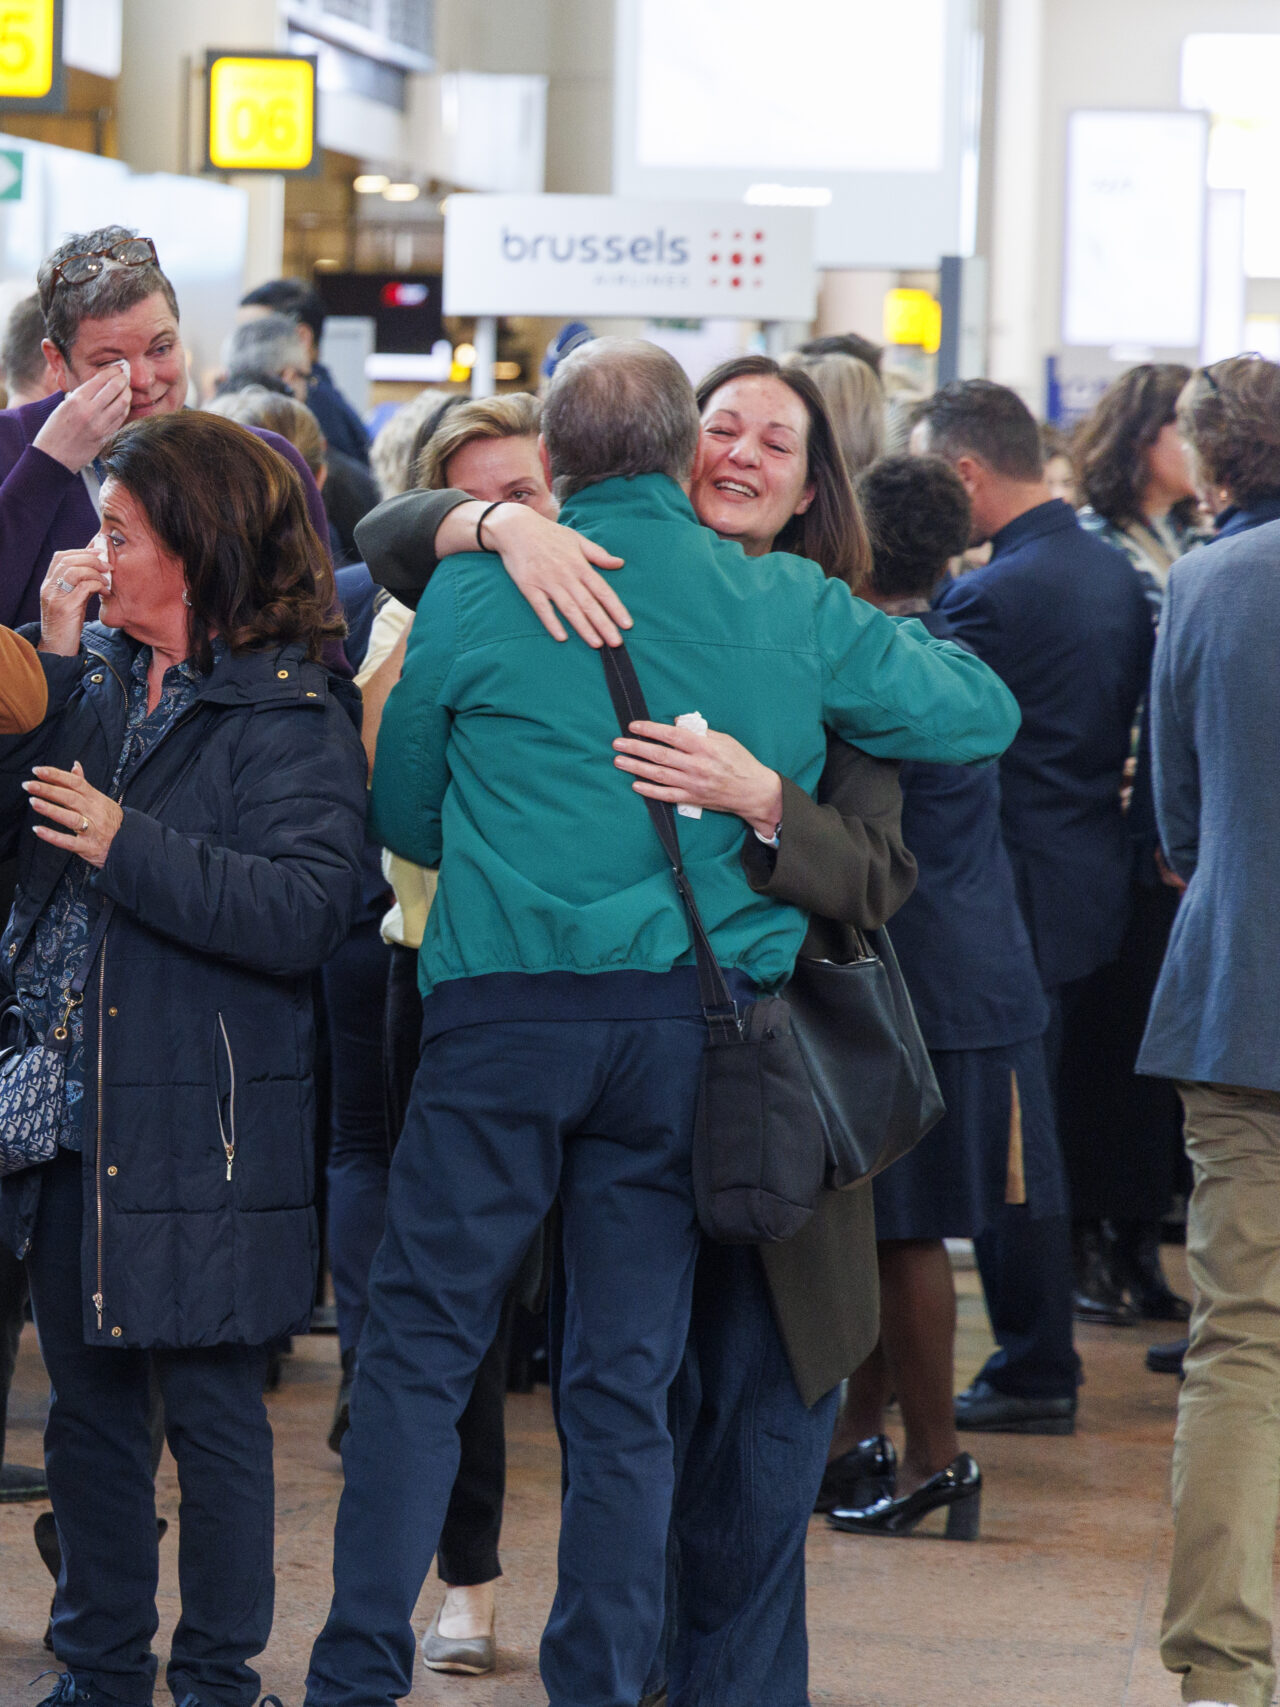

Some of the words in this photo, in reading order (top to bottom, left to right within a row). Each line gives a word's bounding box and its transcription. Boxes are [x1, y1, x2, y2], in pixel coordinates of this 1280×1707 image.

[228, 97, 300, 154] 06
[500, 227, 690, 266] brussels
[592, 272, 689, 288] AIRLINES
